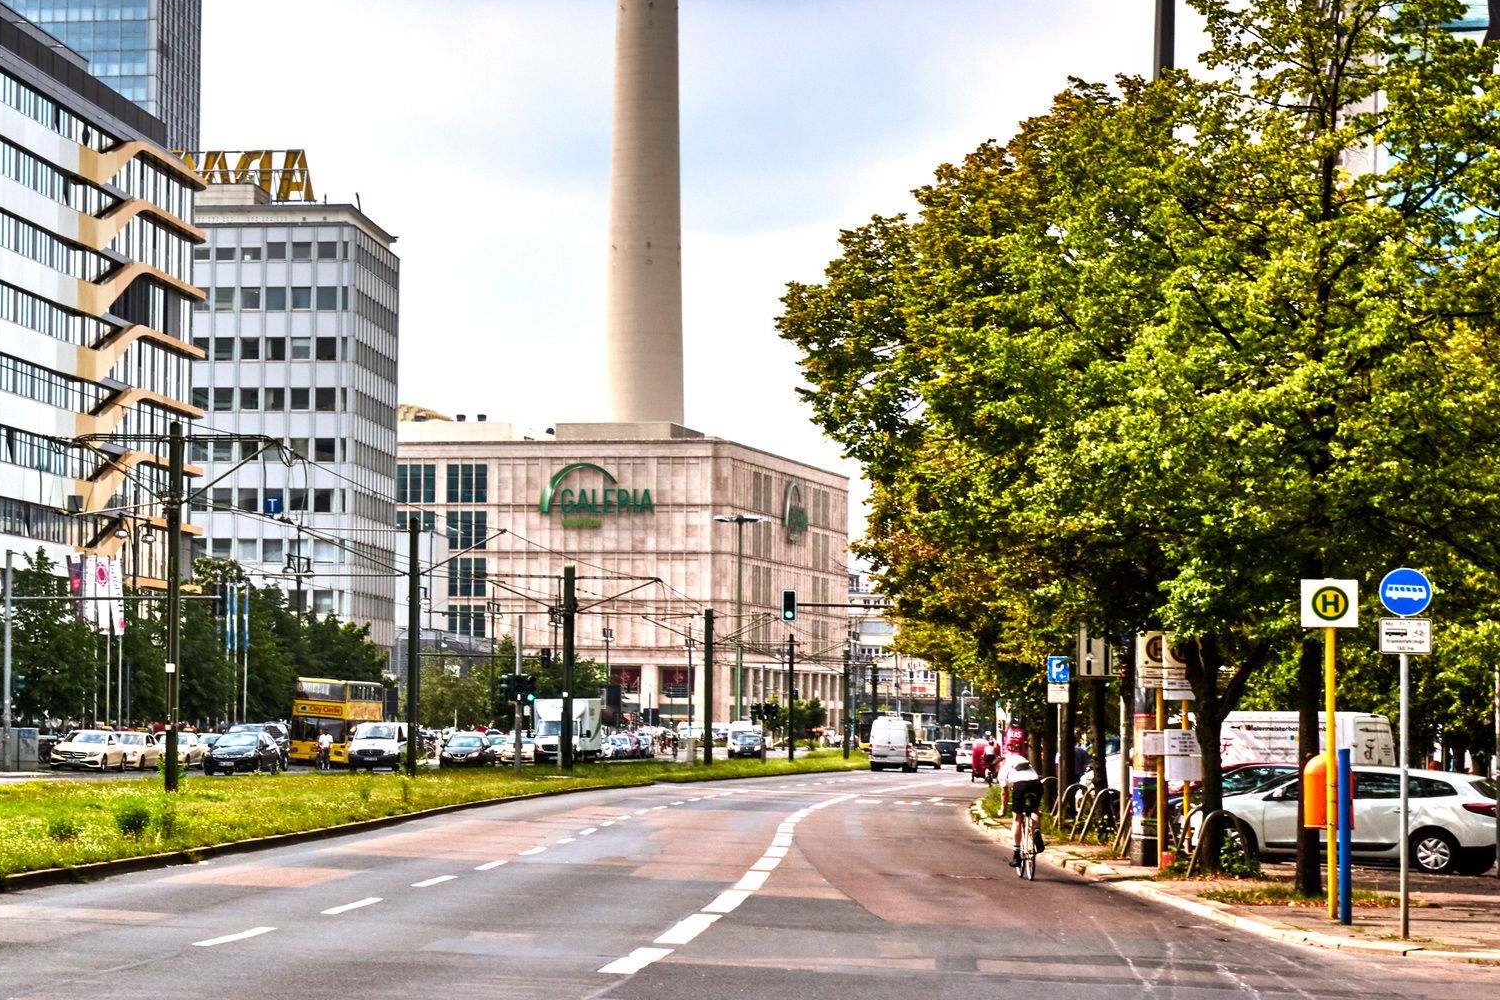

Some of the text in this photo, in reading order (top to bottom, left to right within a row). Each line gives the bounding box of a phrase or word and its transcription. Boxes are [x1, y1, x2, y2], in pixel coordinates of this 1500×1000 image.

[267, 498, 278, 512] T
[561, 488, 655, 514] GALERIA
[1322, 594, 1339, 613] H
[310, 705, 322, 713] City
